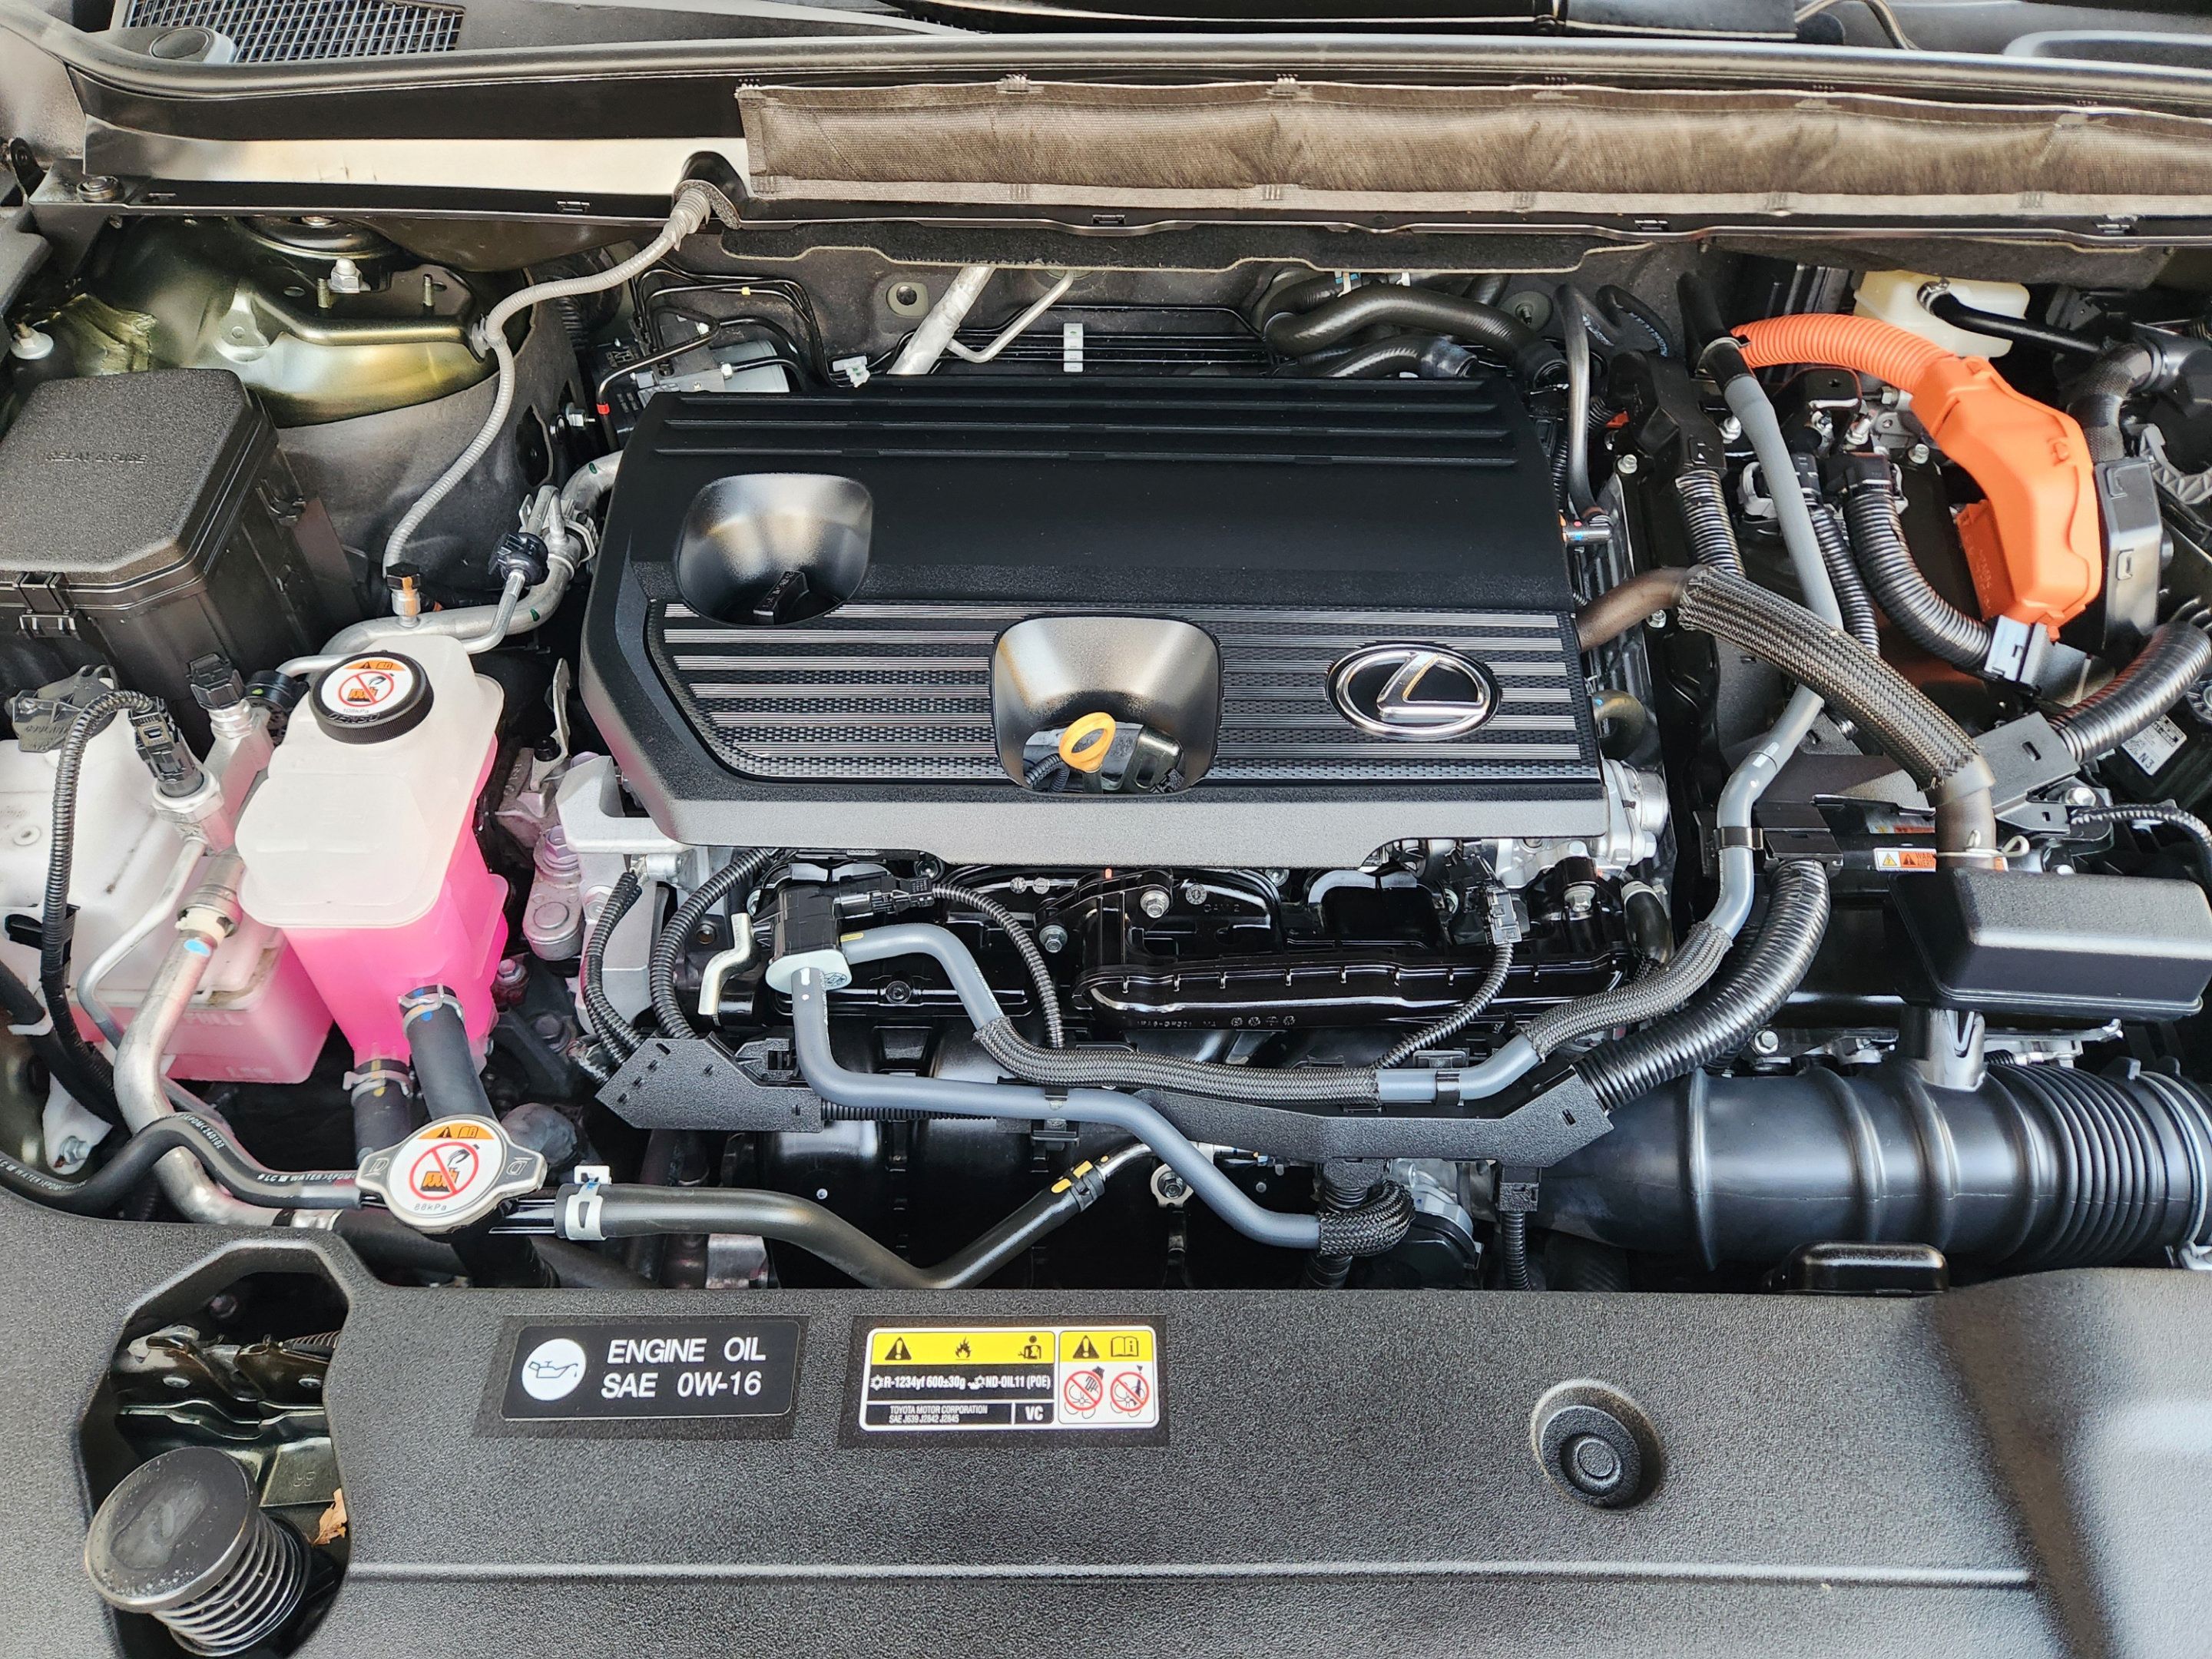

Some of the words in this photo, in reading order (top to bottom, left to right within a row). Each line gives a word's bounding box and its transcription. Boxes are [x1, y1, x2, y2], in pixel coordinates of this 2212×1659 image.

[413, 1203, 447, 1211] 88kPa
[608, 1338, 707, 1364] ENGINE
[724, 1336, 767, 1362] OIL
[601, 1372, 658, 1399] SAE
[677, 1370, 762, 1397] 0W-16
[883, 1376, 925, 1391] R-1234yf
[927, 1376, 966, 1390] 600±30g
[985, 1375, 1025, 1387] ND-OIL11
[1026, 1375, 1051, 1389] (POE)
[890, 1406, 916, 1415] TOYOTA
[916, 1406, 940, 1414] MOTOR
[941, 1405, 988, 1414] CORPORATION
[1025, 1406, 1044, 1421] VC
[889, 1415, 902, 1424] SAE
